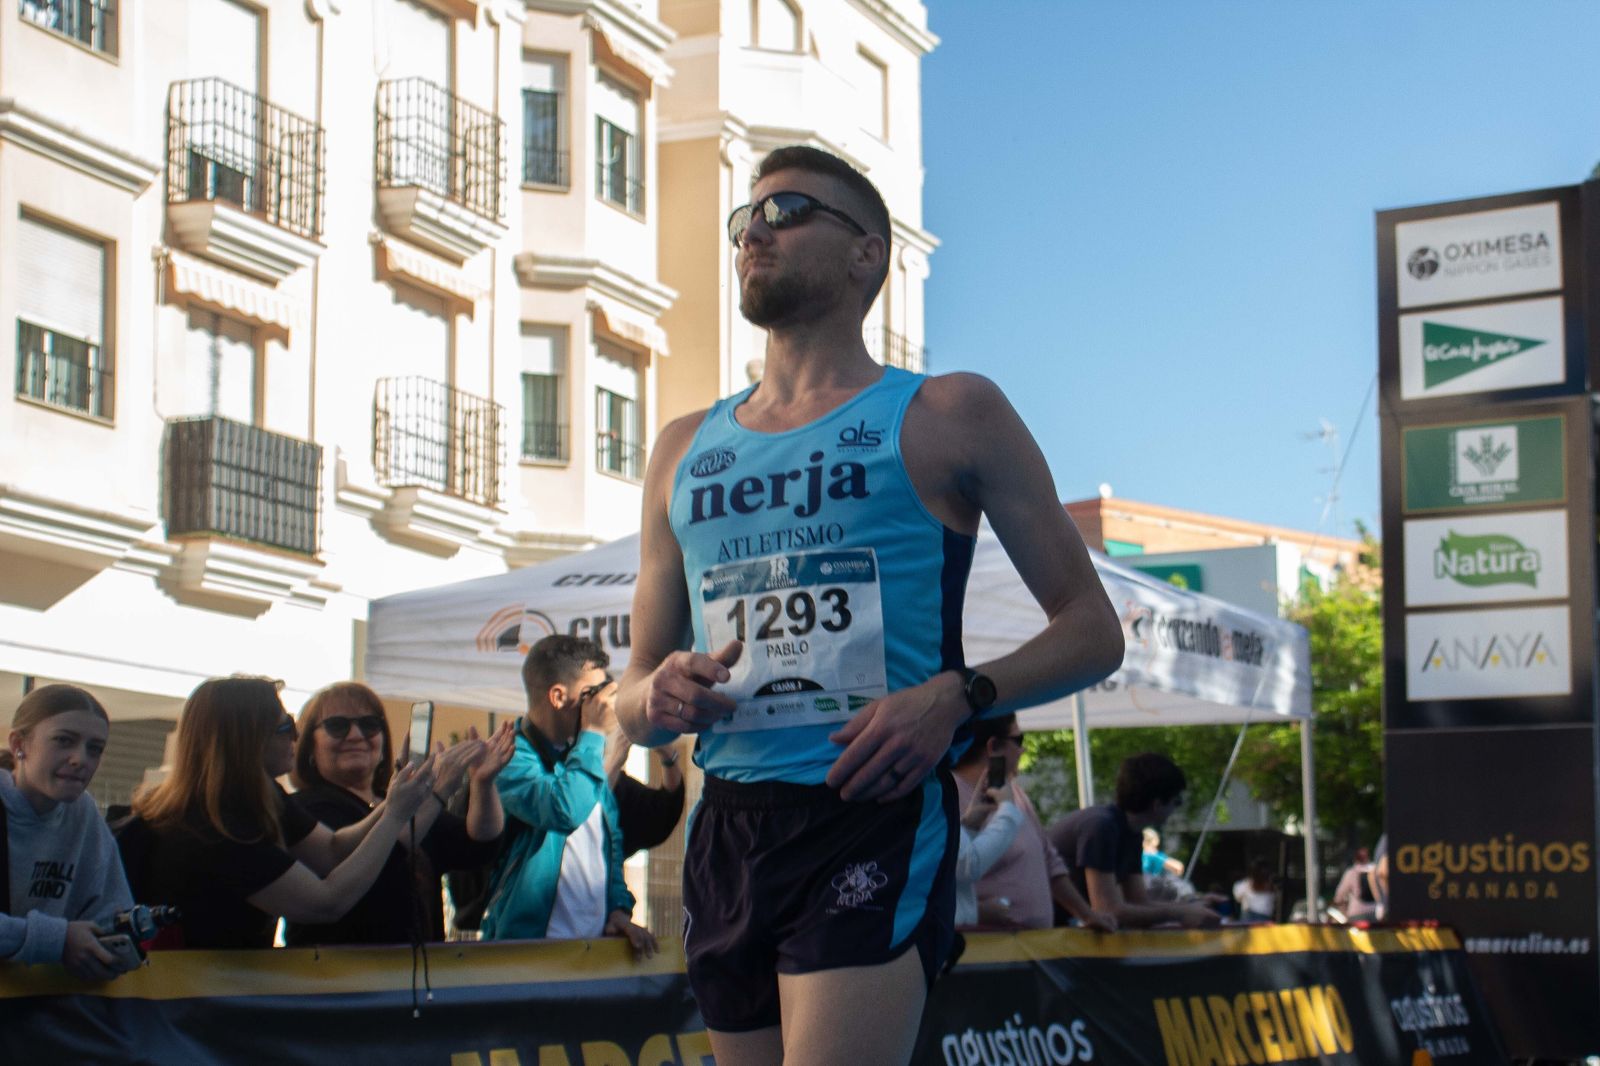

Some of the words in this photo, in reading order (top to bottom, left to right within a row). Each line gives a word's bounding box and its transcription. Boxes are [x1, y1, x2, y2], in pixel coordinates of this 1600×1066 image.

[1444, 232, 1549, 261] OXIMESA
[688, 451, 869, 524] nerja
[717, 523, 844, 562] ATLETISMO
[1436, 548, 1539, 578] Natura
[727, 588, 852, 643] 1293
[766, 640, 809, 659] PABLO
[1422, 632, 1557, 673] ANAYA
[1396, 832, 1590, 885] agustinos
[28, 880, 66, 899] KIND
[1428, 880, 1559, 900] GRANADA
[942, 1012, 1094, 1066] agustinos
[1153, 984, 1355, 1066] MARCELINO
